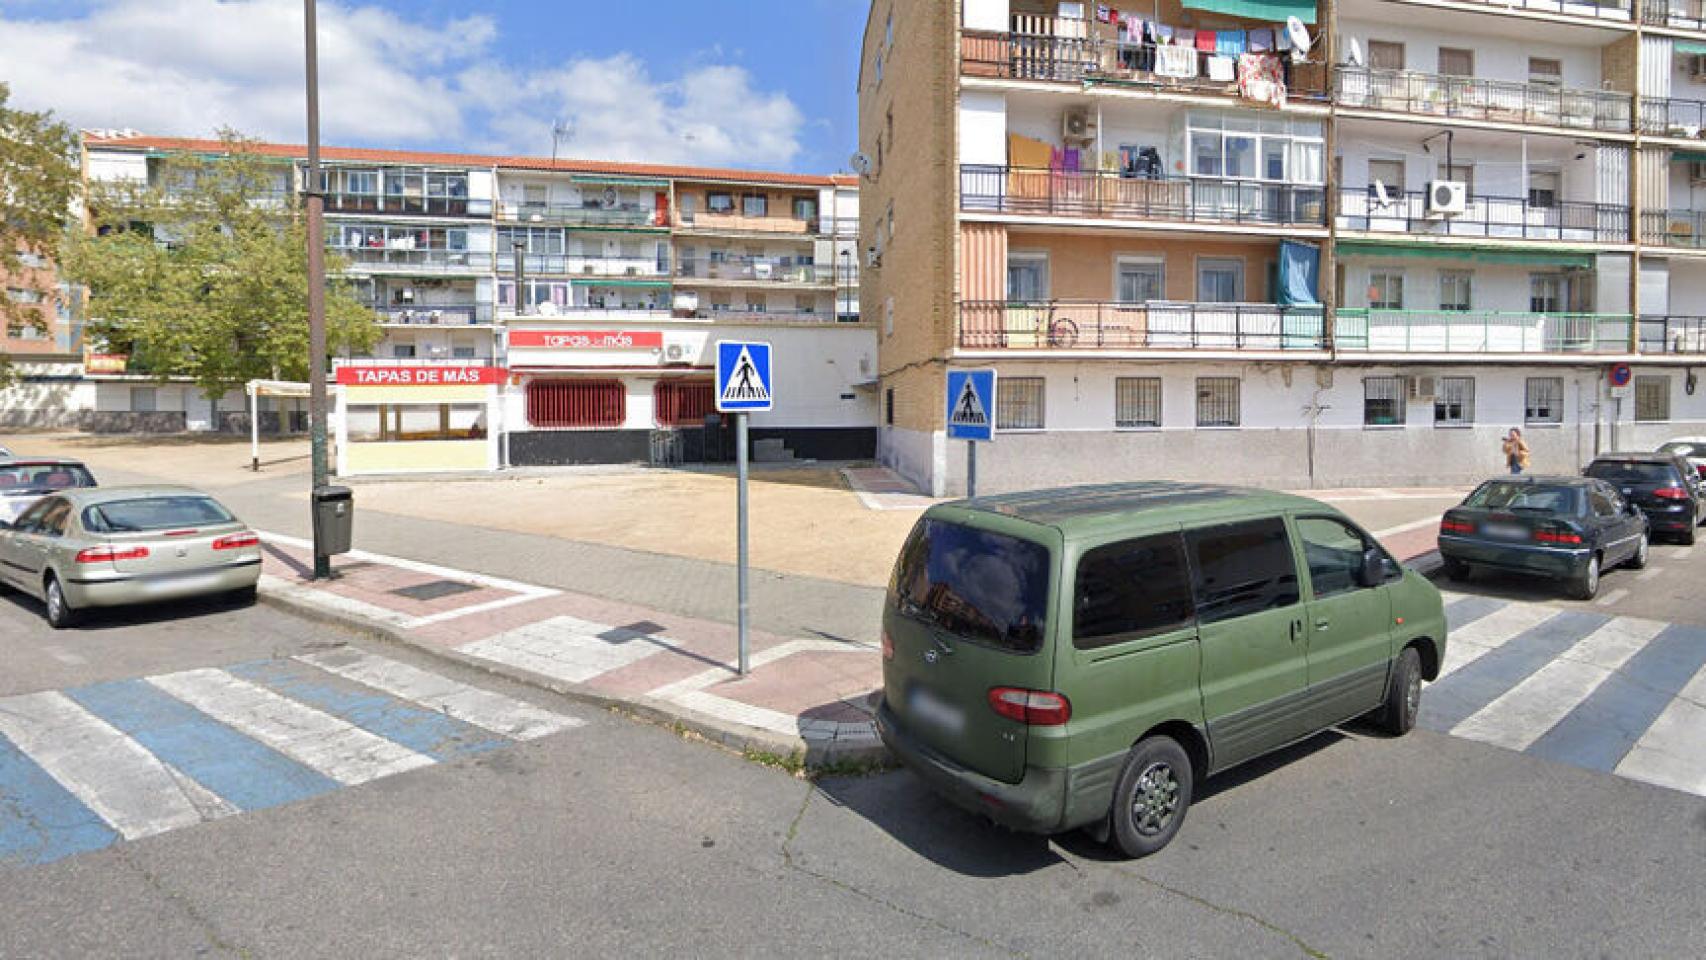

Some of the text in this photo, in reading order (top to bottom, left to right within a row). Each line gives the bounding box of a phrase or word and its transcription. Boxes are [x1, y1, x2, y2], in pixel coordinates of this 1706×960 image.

[356, 366, 480, 382] TAPAS DE MÁS
